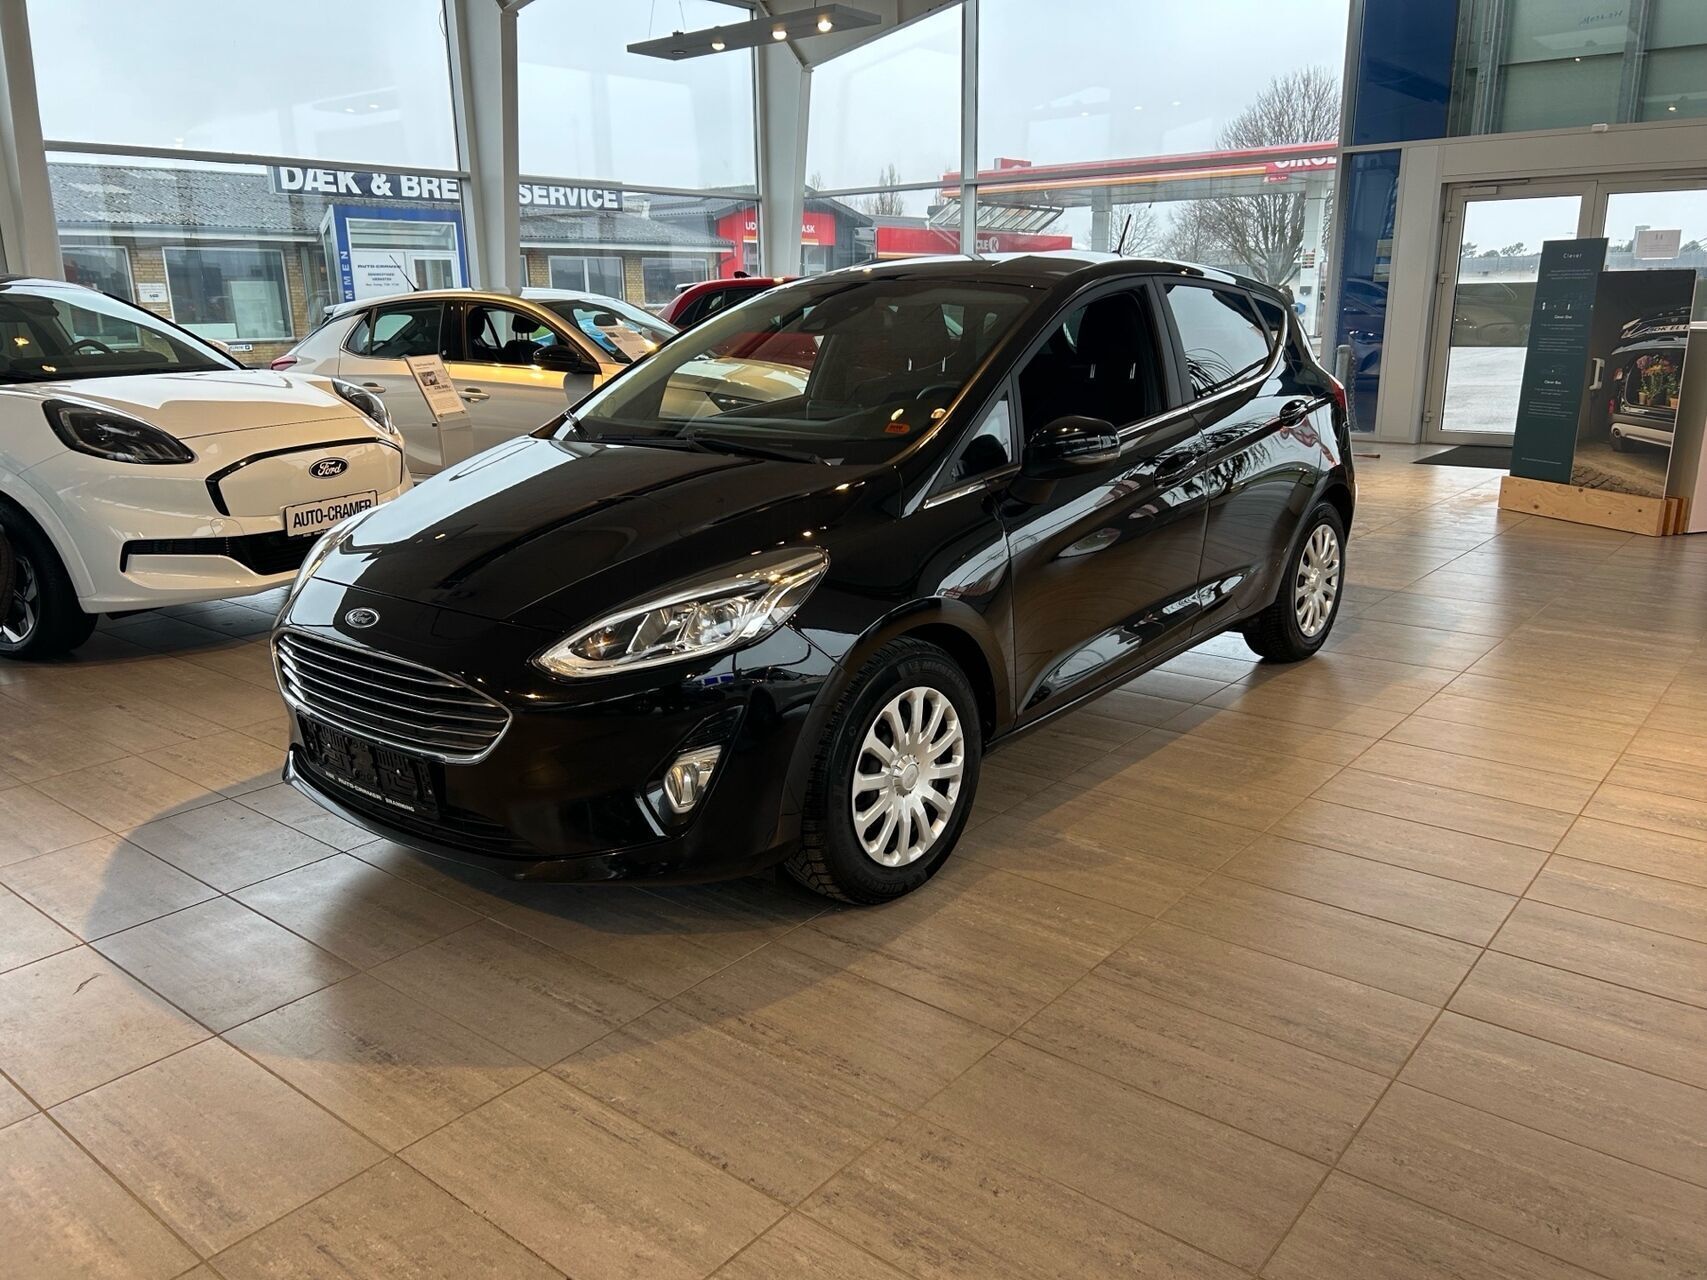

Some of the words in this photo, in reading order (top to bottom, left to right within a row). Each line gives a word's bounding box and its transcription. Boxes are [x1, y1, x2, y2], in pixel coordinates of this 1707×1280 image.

[279, 166, 362, 195] DÆK
[370, 173, 393, 196] &
[519, 184, 618, 208] SERVICE
[317, 461, 342, 476] Ford
[293, 499, 372, 529] AUTO-CRAMER
